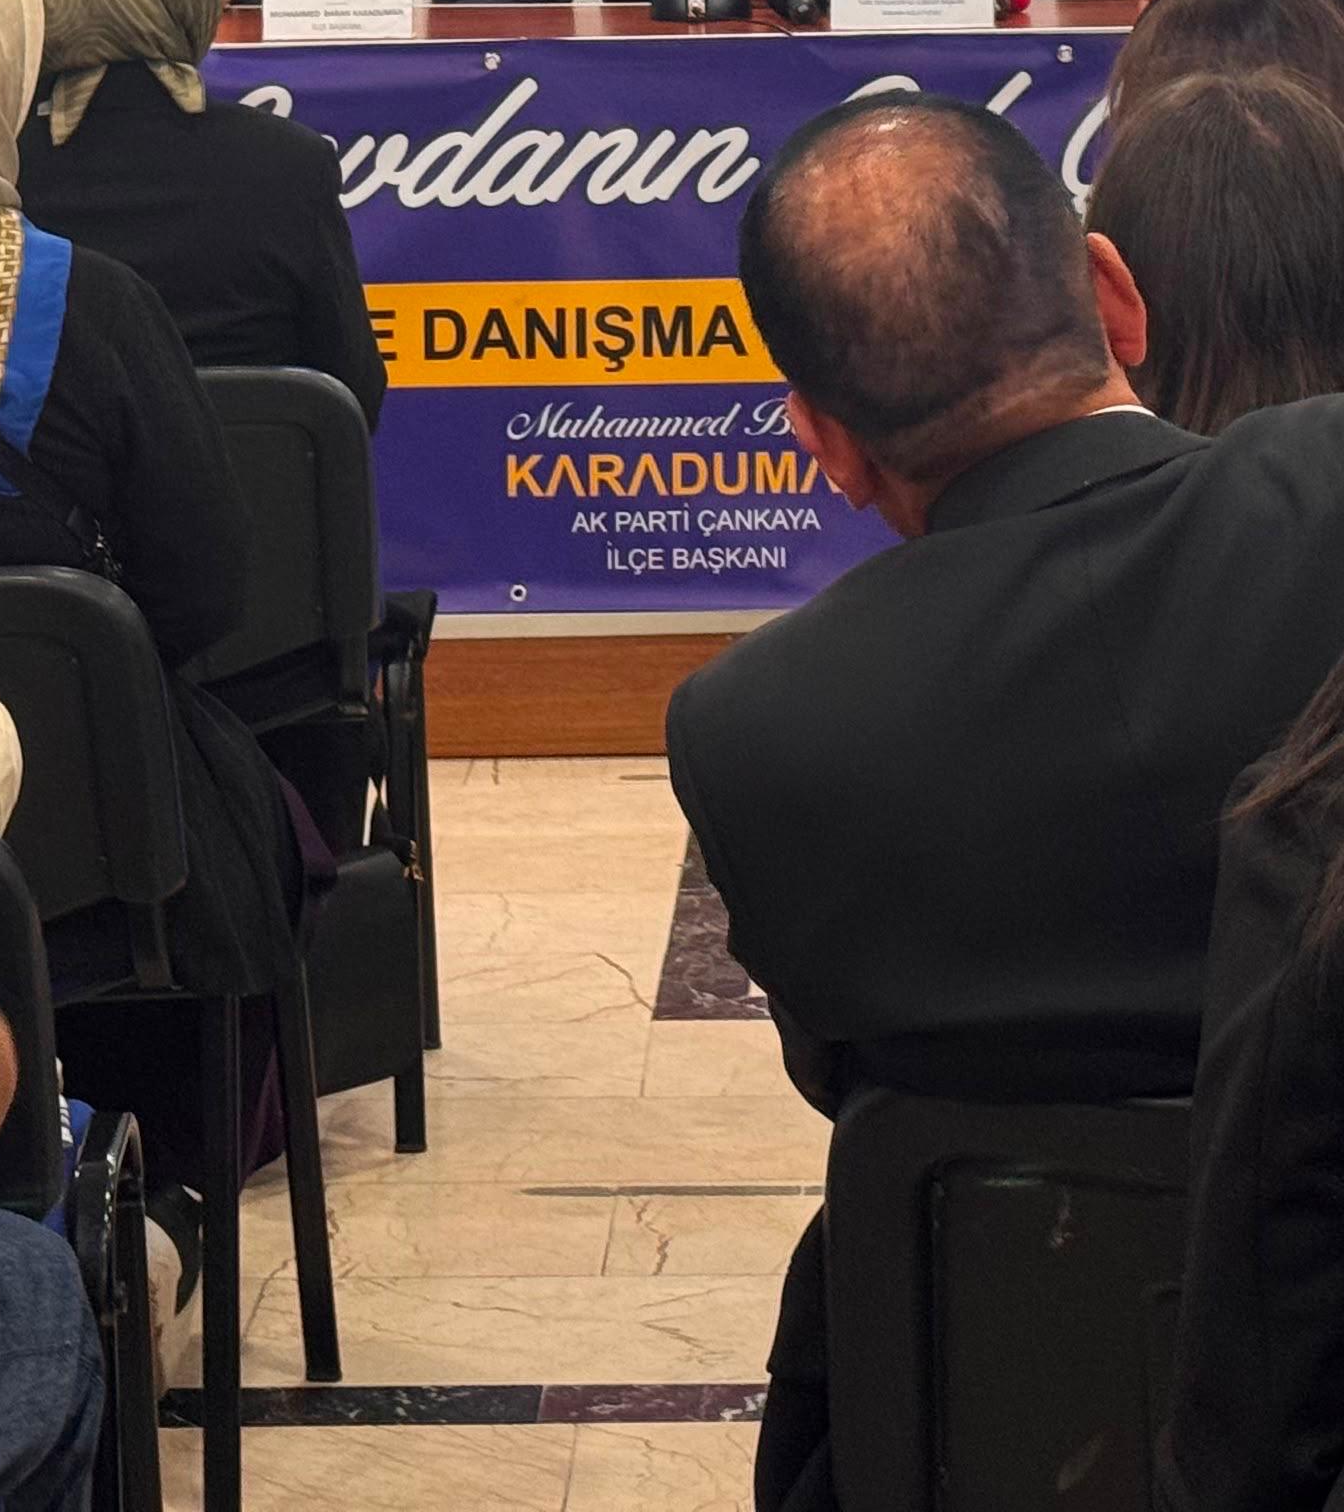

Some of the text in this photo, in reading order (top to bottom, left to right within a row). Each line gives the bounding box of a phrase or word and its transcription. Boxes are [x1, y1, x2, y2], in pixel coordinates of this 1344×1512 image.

[423, 305, 749, 373] DANIŞMA
[506, 401, 742, 441] Muhammed
[506, 451, 845, 498] KARADUMA
[571, 503, 823, 537] AK PARTİ ÇANKAYA
[606, 541, 787, 575] İLÇE BAŞKANI
